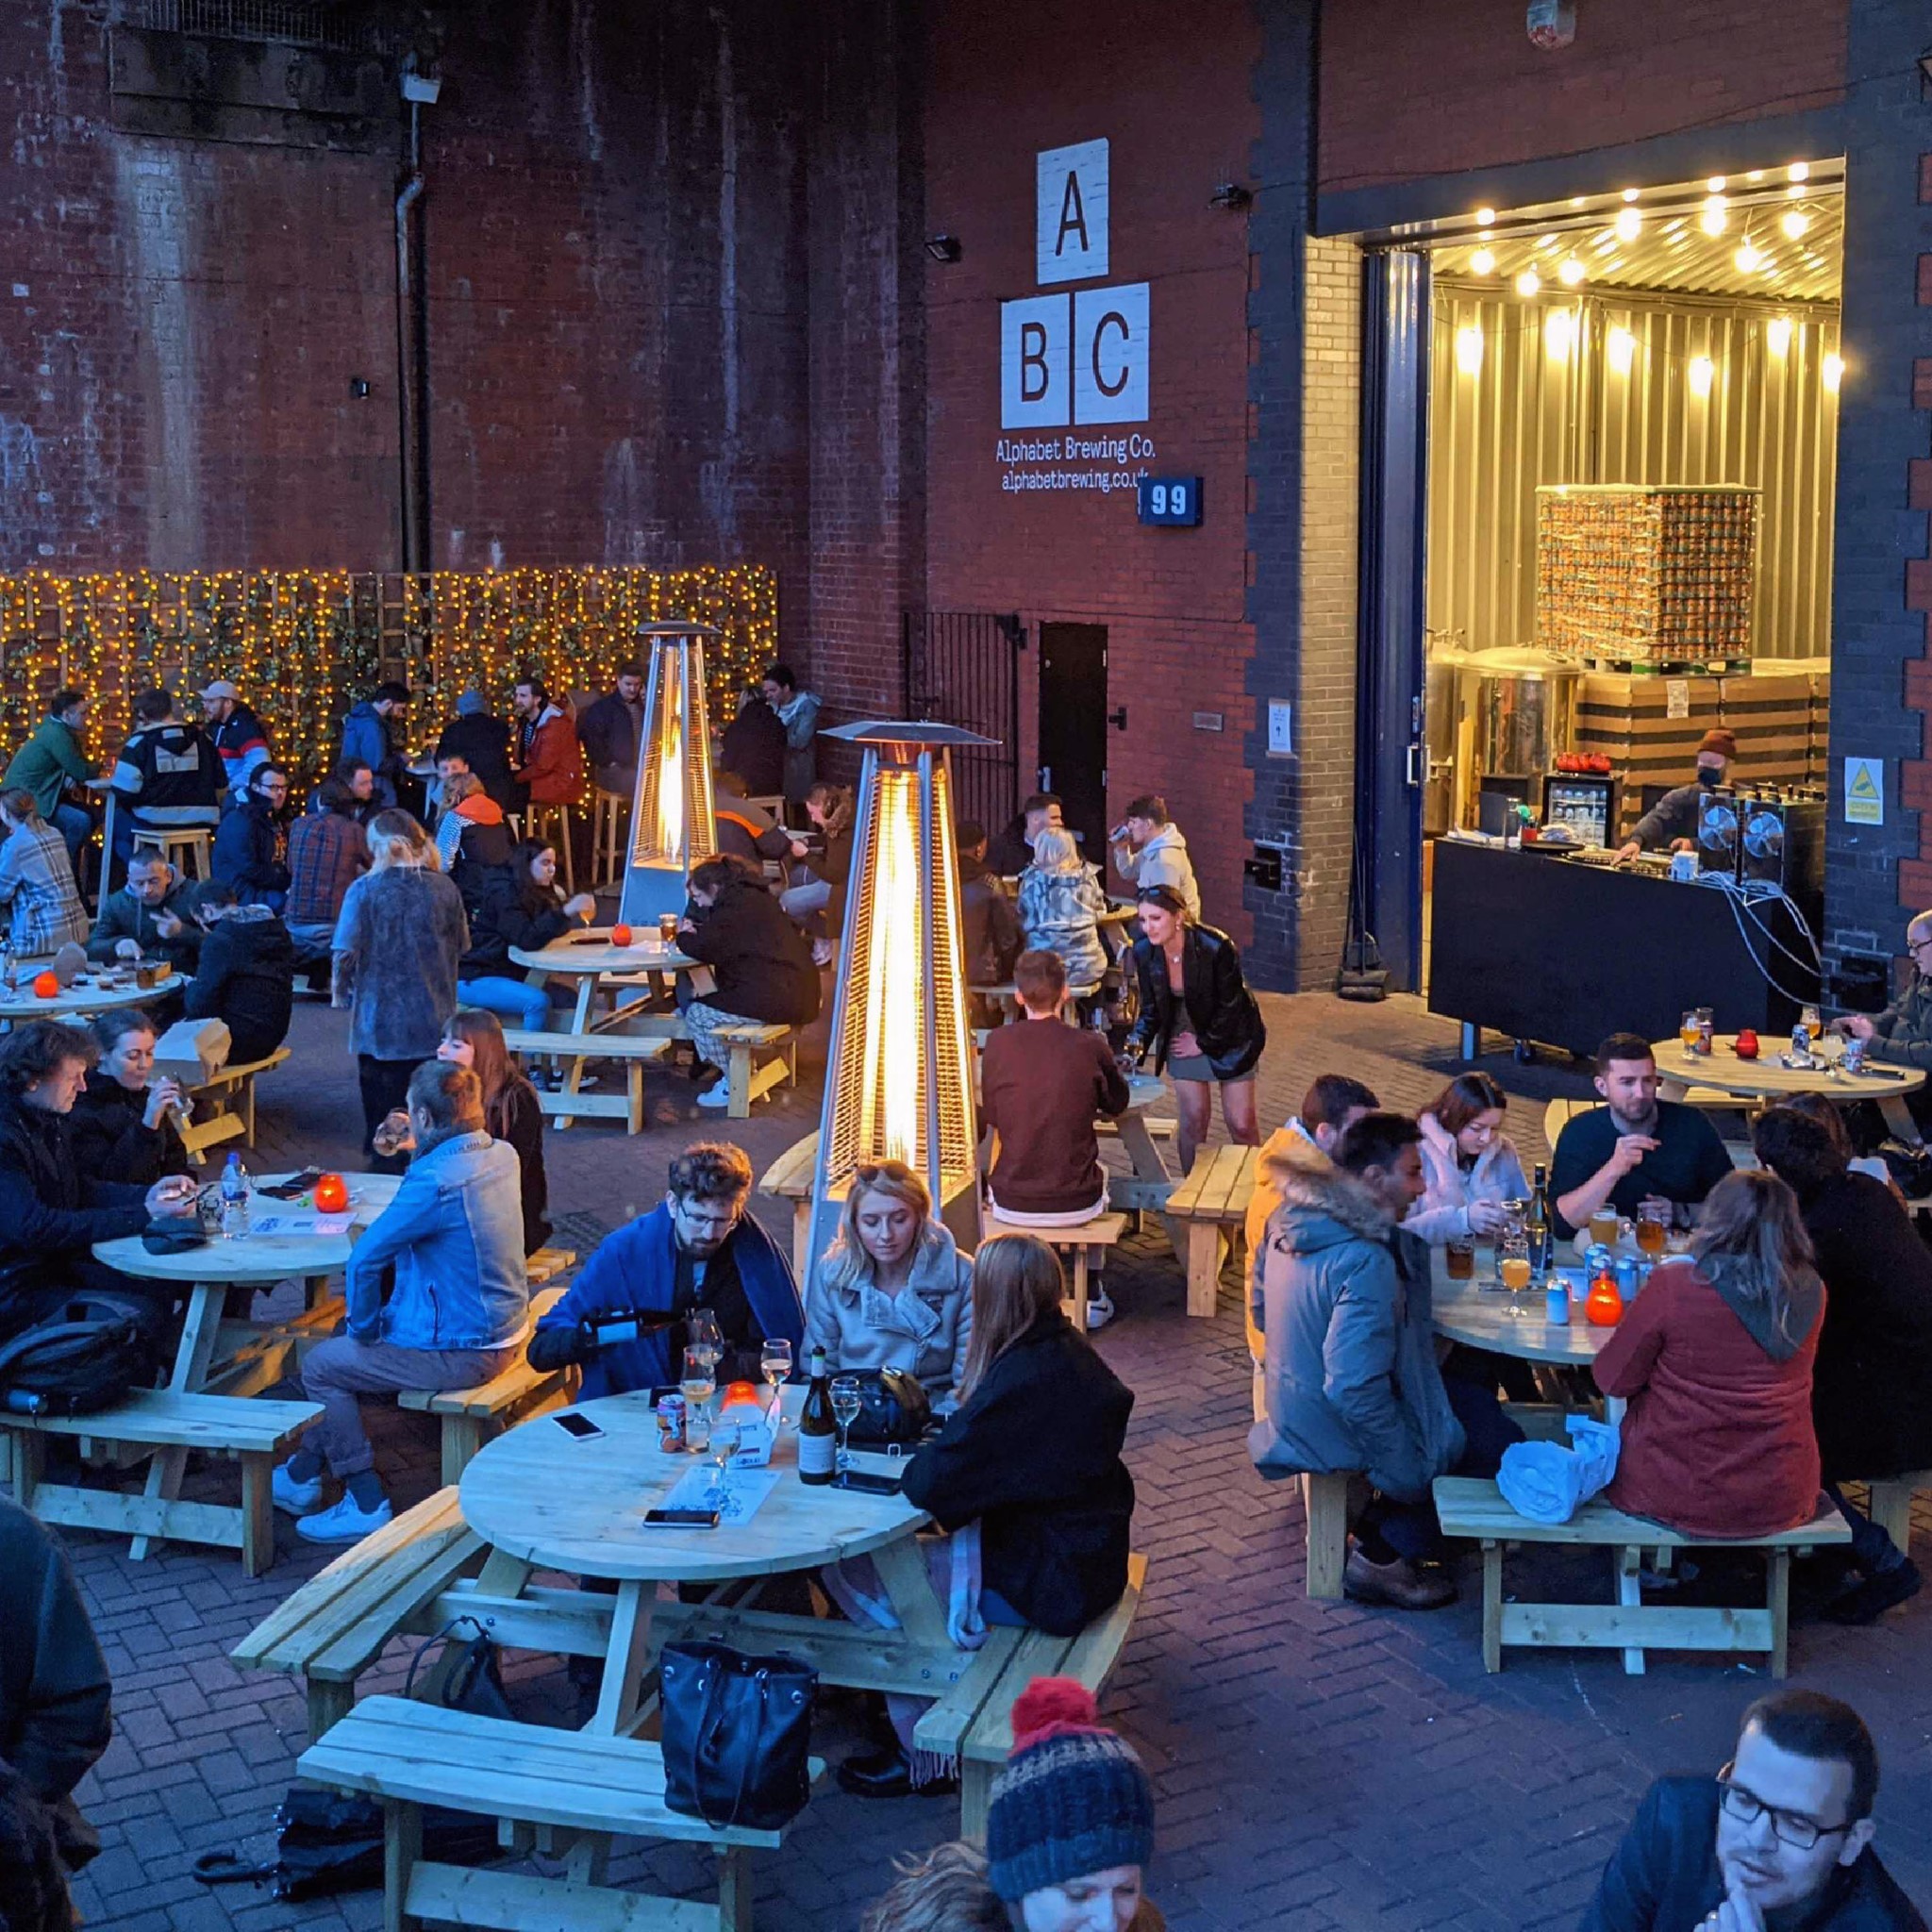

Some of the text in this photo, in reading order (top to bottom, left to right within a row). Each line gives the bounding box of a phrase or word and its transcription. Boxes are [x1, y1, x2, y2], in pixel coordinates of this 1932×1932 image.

[1055, 170, 1089, 257] A
[1021, 311, 1129, 403] B C
[996, 433, 1156, 467] Alphabet Brewing Co.
[1152, 485, 1186, 515] 99
